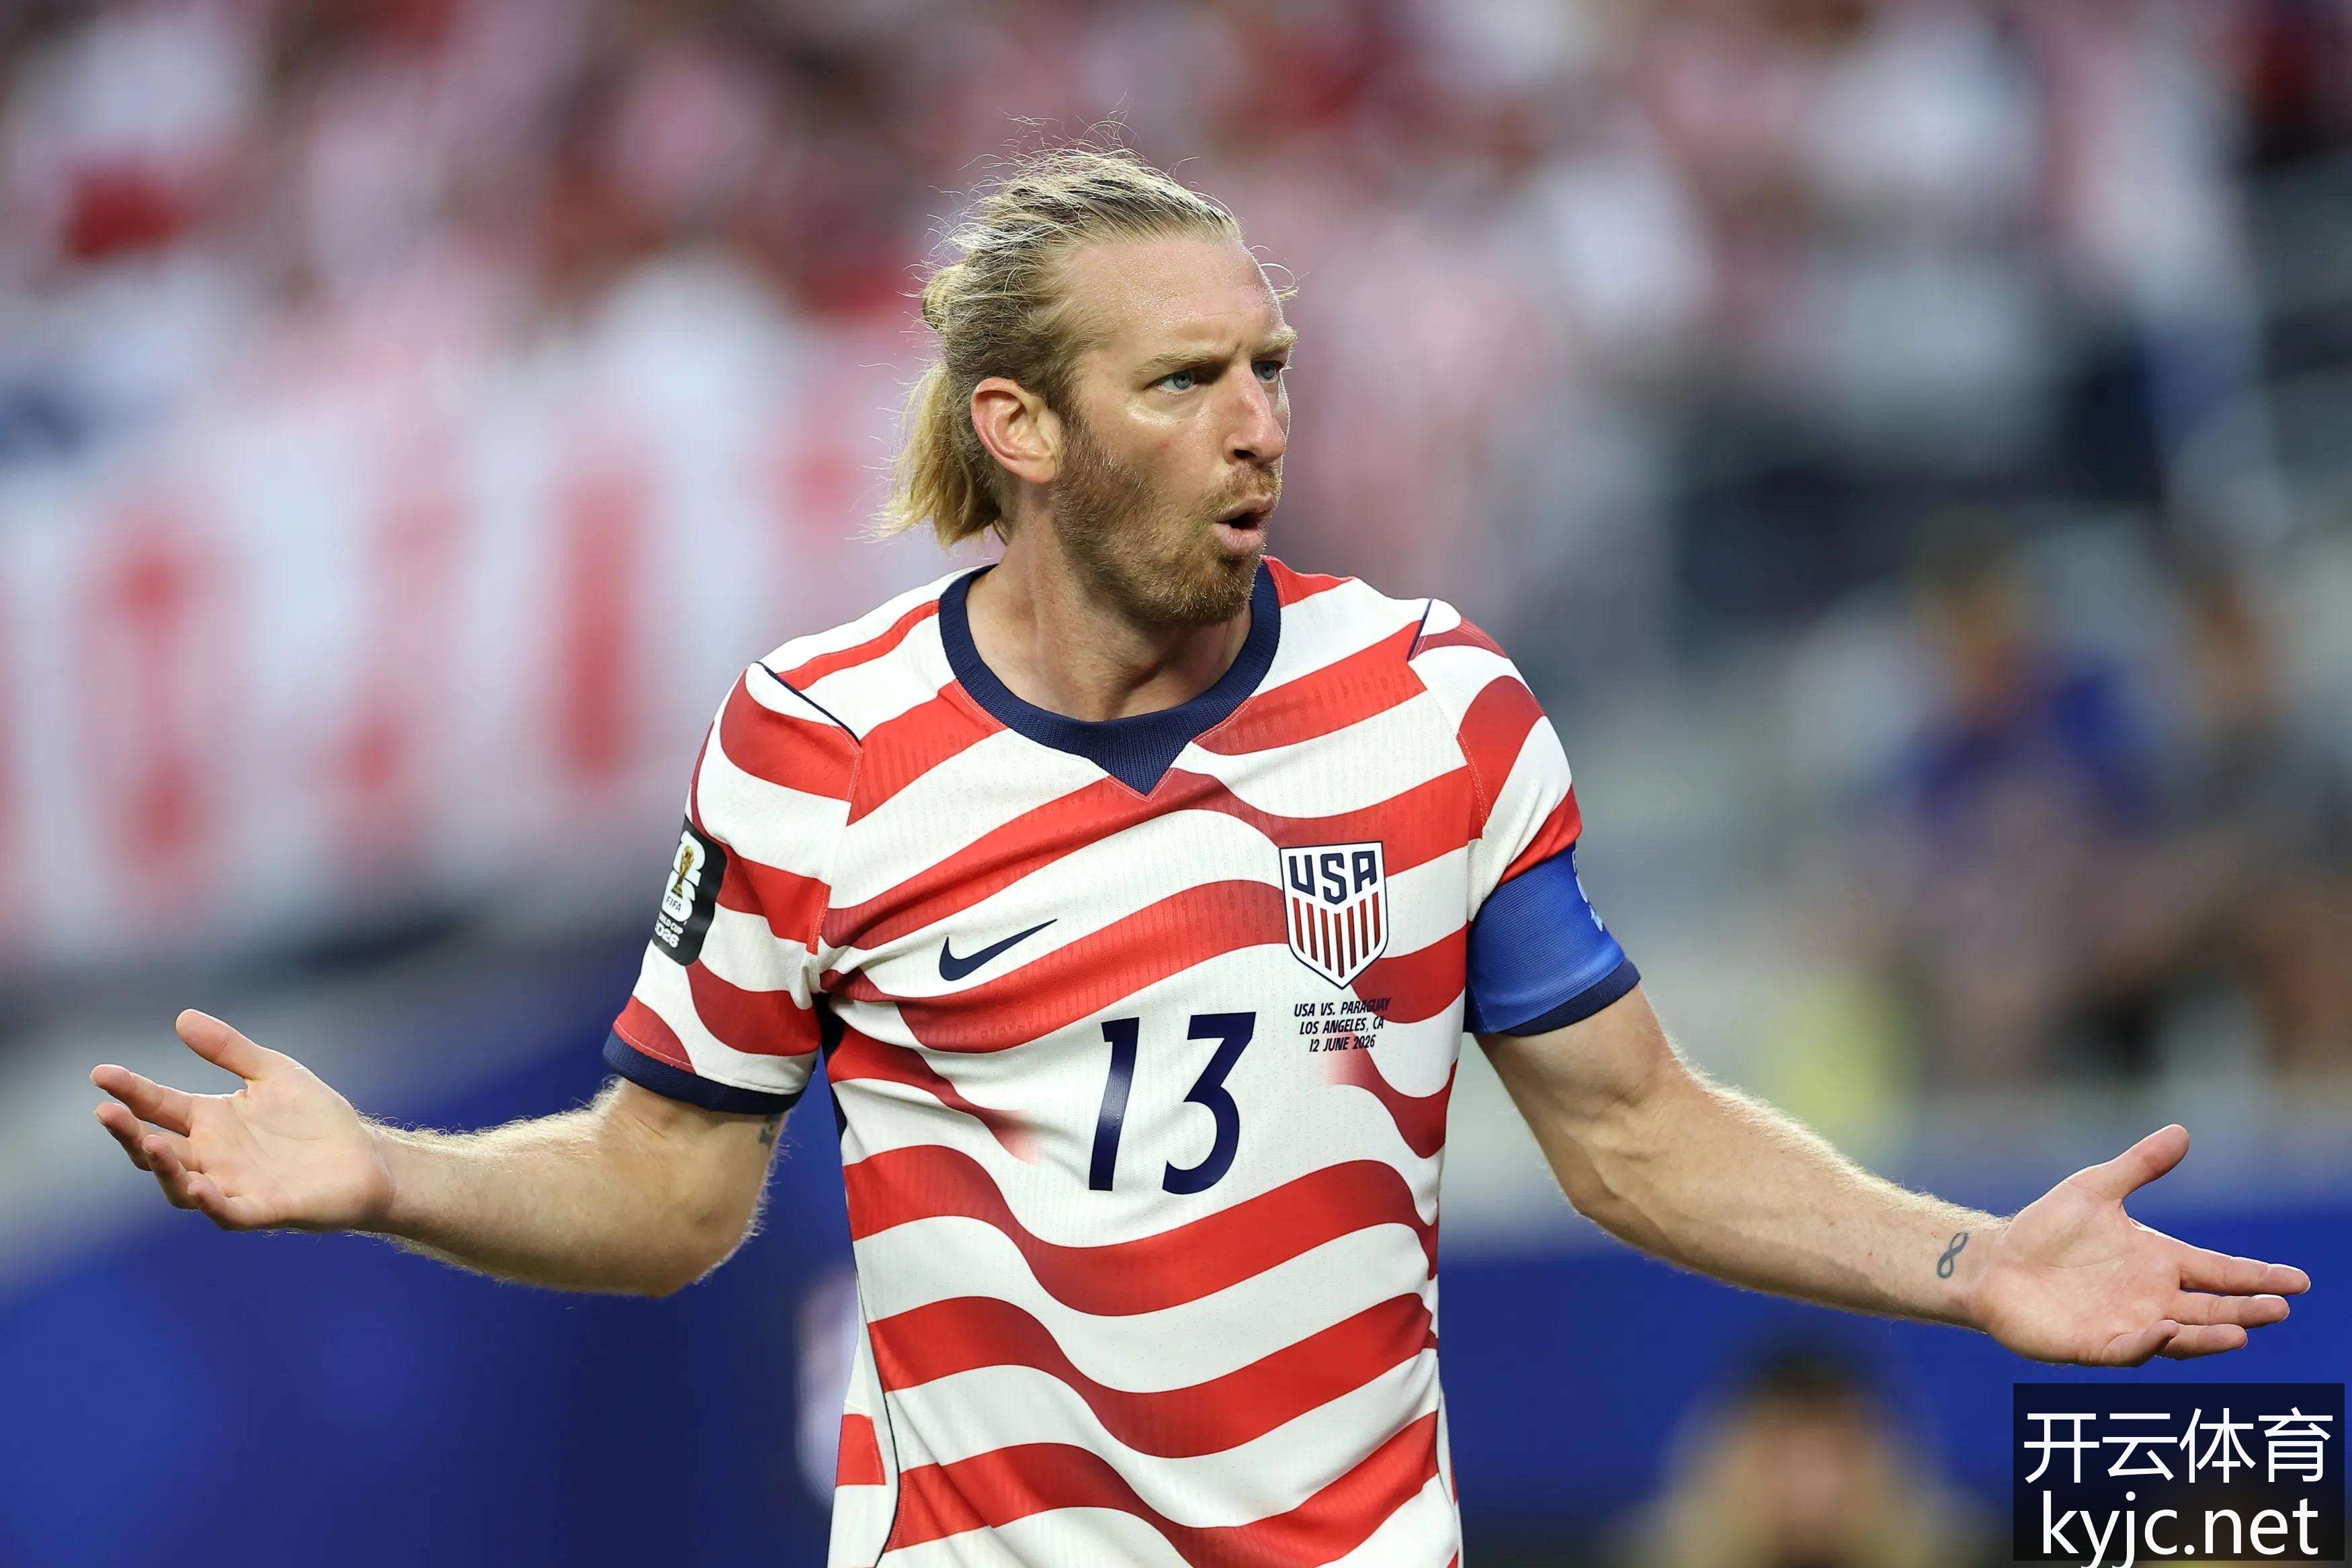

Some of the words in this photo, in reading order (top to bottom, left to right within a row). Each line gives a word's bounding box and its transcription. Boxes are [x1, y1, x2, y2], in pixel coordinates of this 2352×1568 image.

[1288, 851, 1377, 905] USA
[665, 896, 681, 912] FIFA
[670, 922, 683, 935] CUP
[1294, 1003, 1315, 1016] USA
[1320, 1002, 1335, 1016] VS.
[1340, 997, 1391, 1014] PARAGUAY
[1300, 1021, 1319, 1035] LOS
[1322, 1017, 1369, 1033] ANGELES,
[1373, 1016, 1384, 1029] CA
[1309, 1039, 1320, 1052] 12
[1322, 1037, 1350, 1051] JUNE
[1352, 1034, 1376, 1049] 2026
[1089, 1011, 1257, 1195] 13
